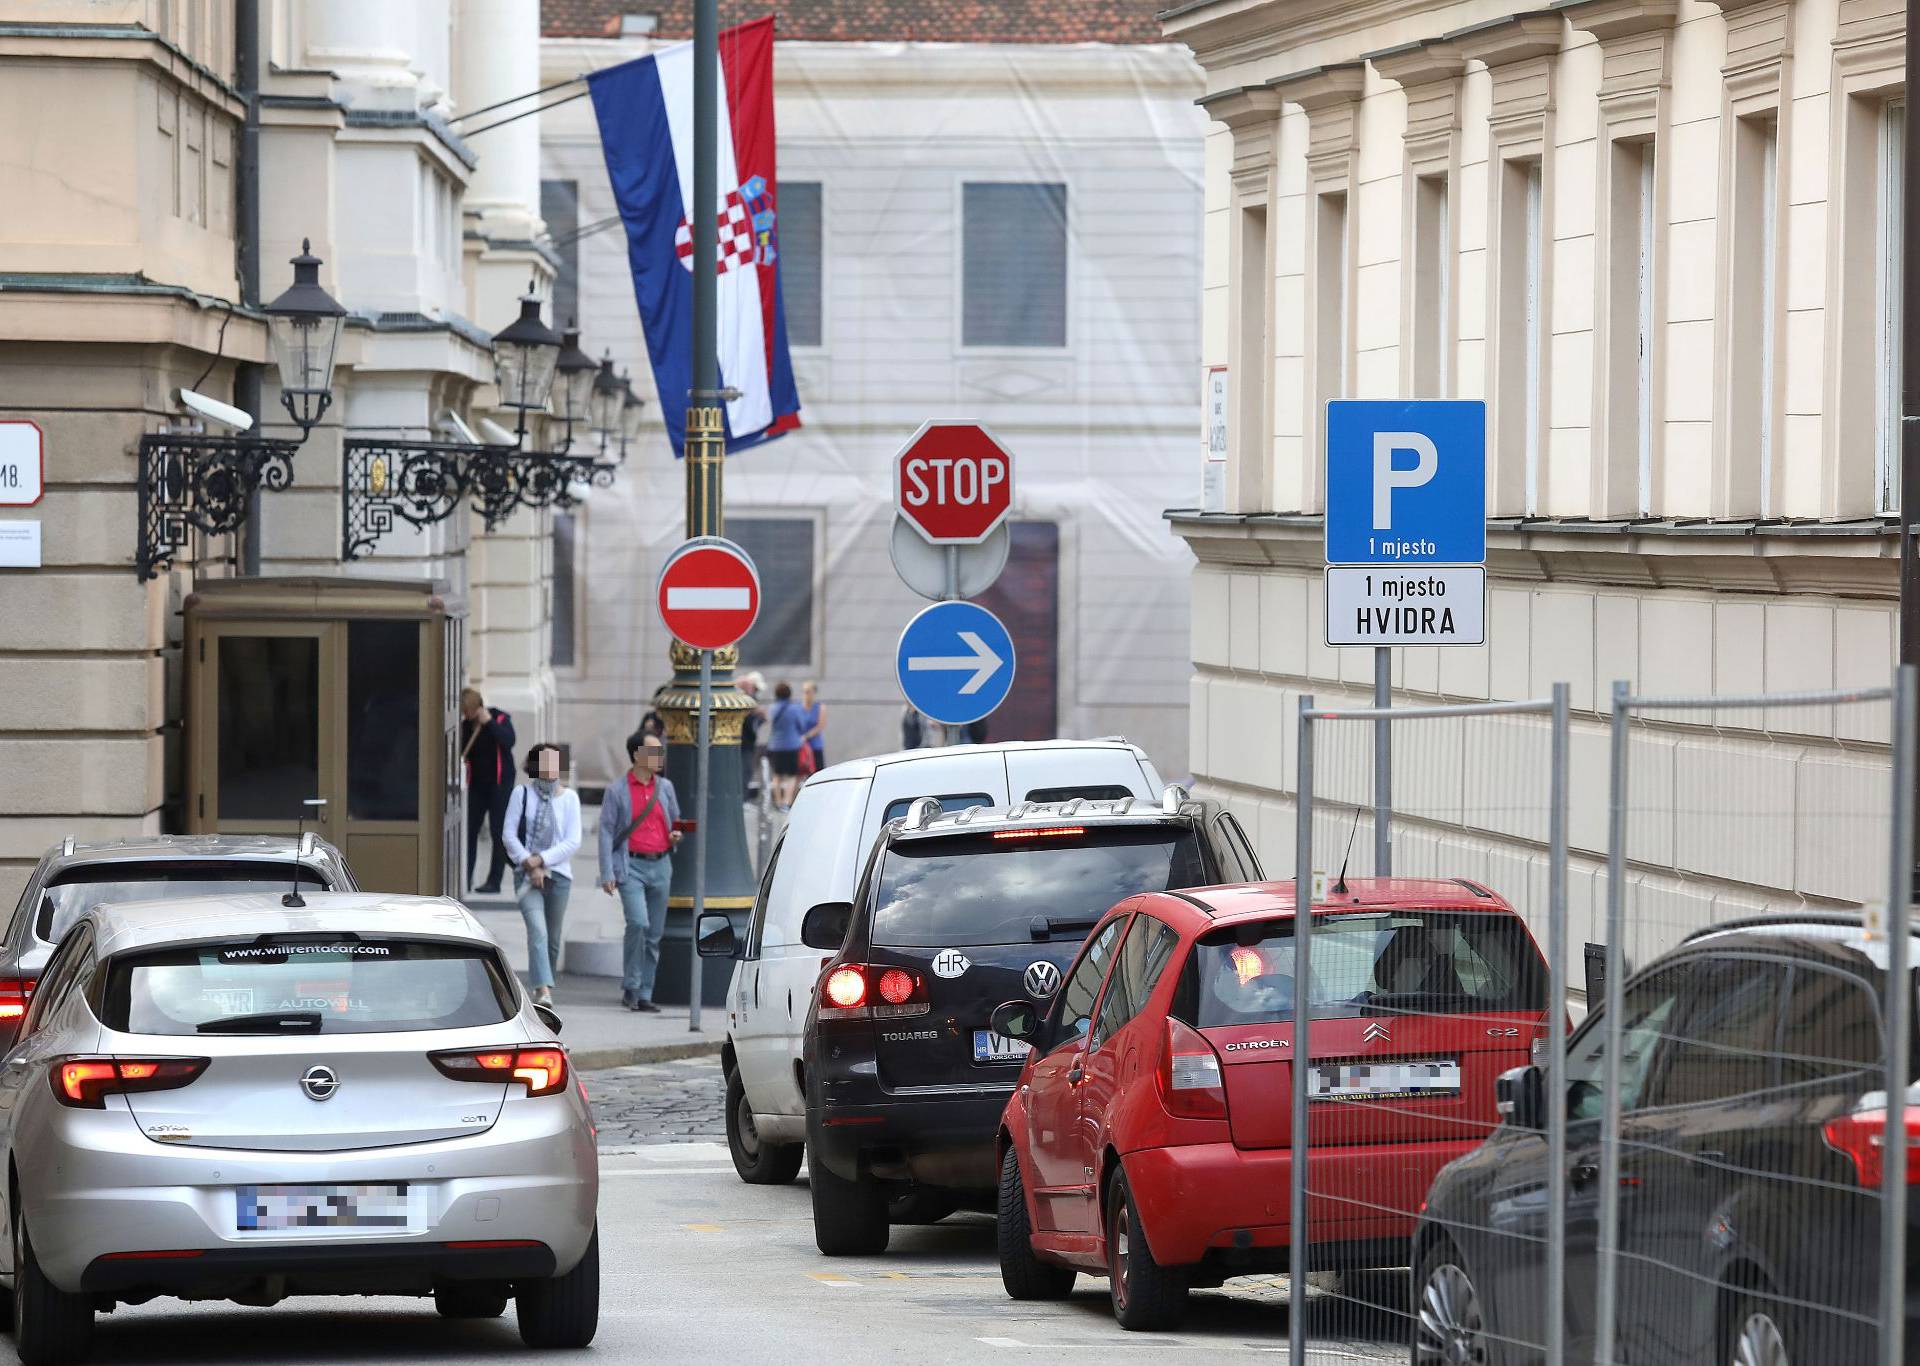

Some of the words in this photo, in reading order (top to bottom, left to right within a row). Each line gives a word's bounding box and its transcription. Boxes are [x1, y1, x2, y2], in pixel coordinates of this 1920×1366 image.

[906, 458, 1005, 506] STOP
[1373, 432, 1438, 529] P
[1369, 538, 1375, 555] 1
[1382, 538, 1436, 559] mjesto
[1366, 575, 1372, 597] 1
[1382, 576, 1446, 602] mjesto
[1357, 608, 1455, 634] HVIDRA
[224, 945, 390, 959] www.willrentacar.com
[938, 954, 965, 972] HR
[882, 1030, 938, 1041] TOUAREG
[1487, 1027, 1519, 1037] C2
[977, 1046, 988, 1054] HR
